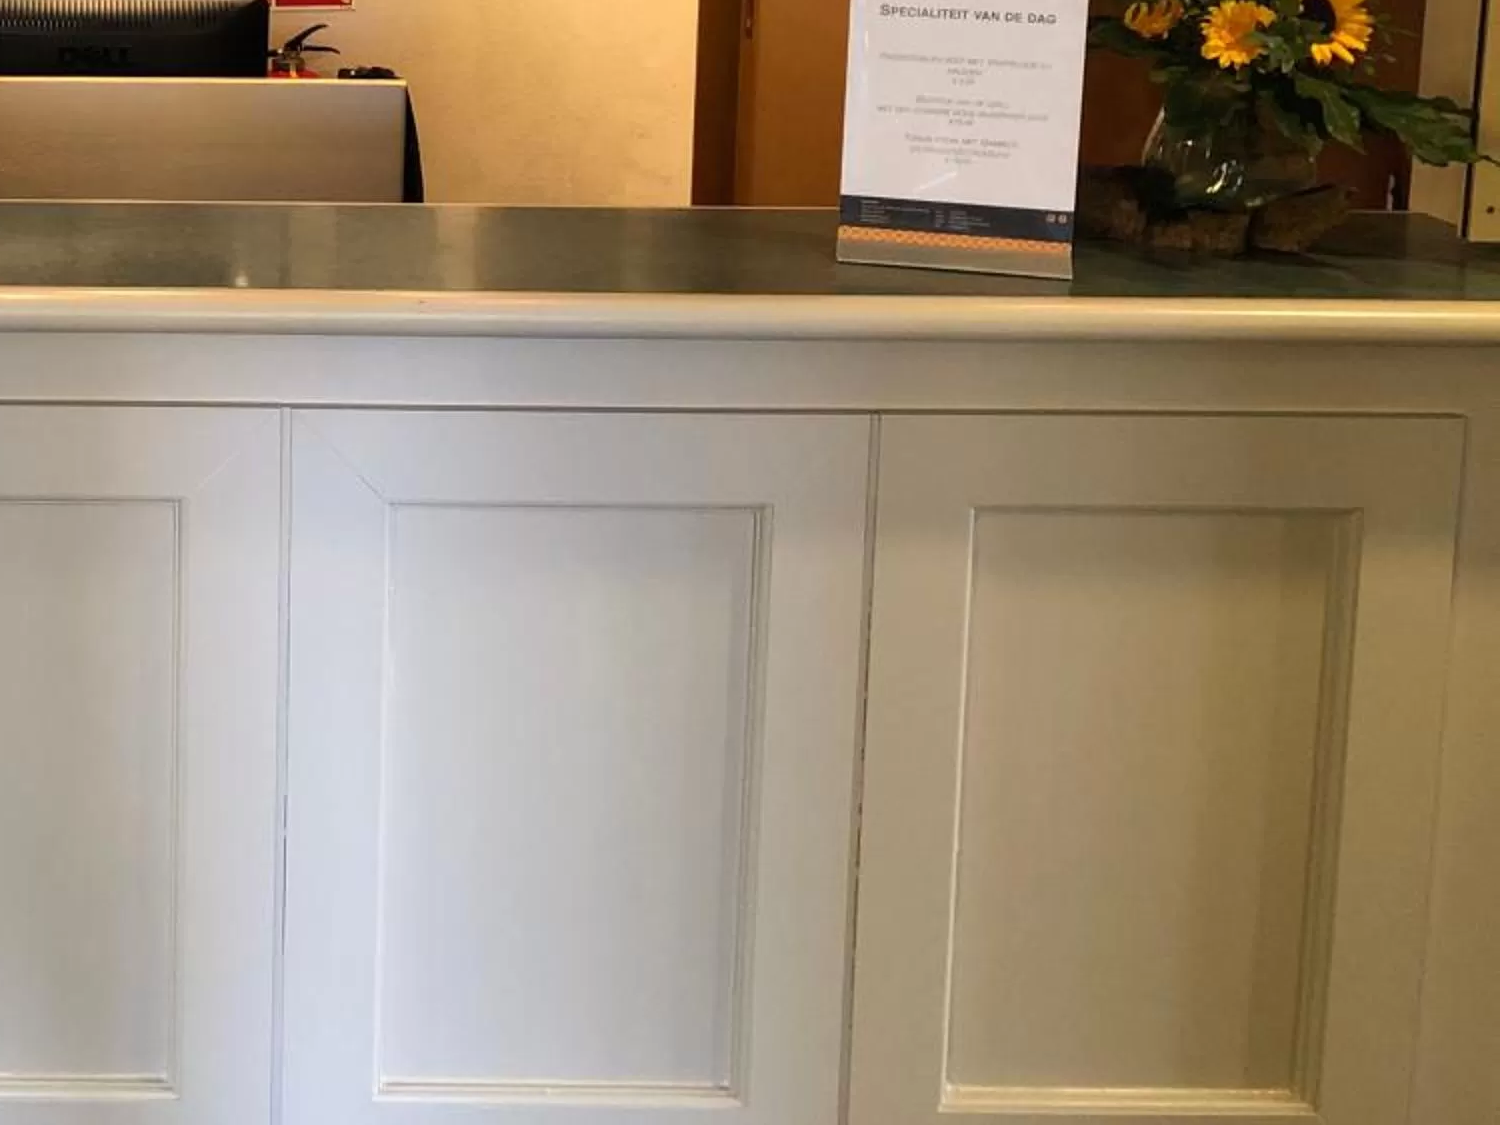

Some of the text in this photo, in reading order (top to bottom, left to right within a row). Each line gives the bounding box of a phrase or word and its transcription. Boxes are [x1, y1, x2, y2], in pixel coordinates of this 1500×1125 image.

[973, 10, 1000, 22] VAN
[1004, 12, 1023, 23] DE
[1027, 13, 1057, 25] DAG
